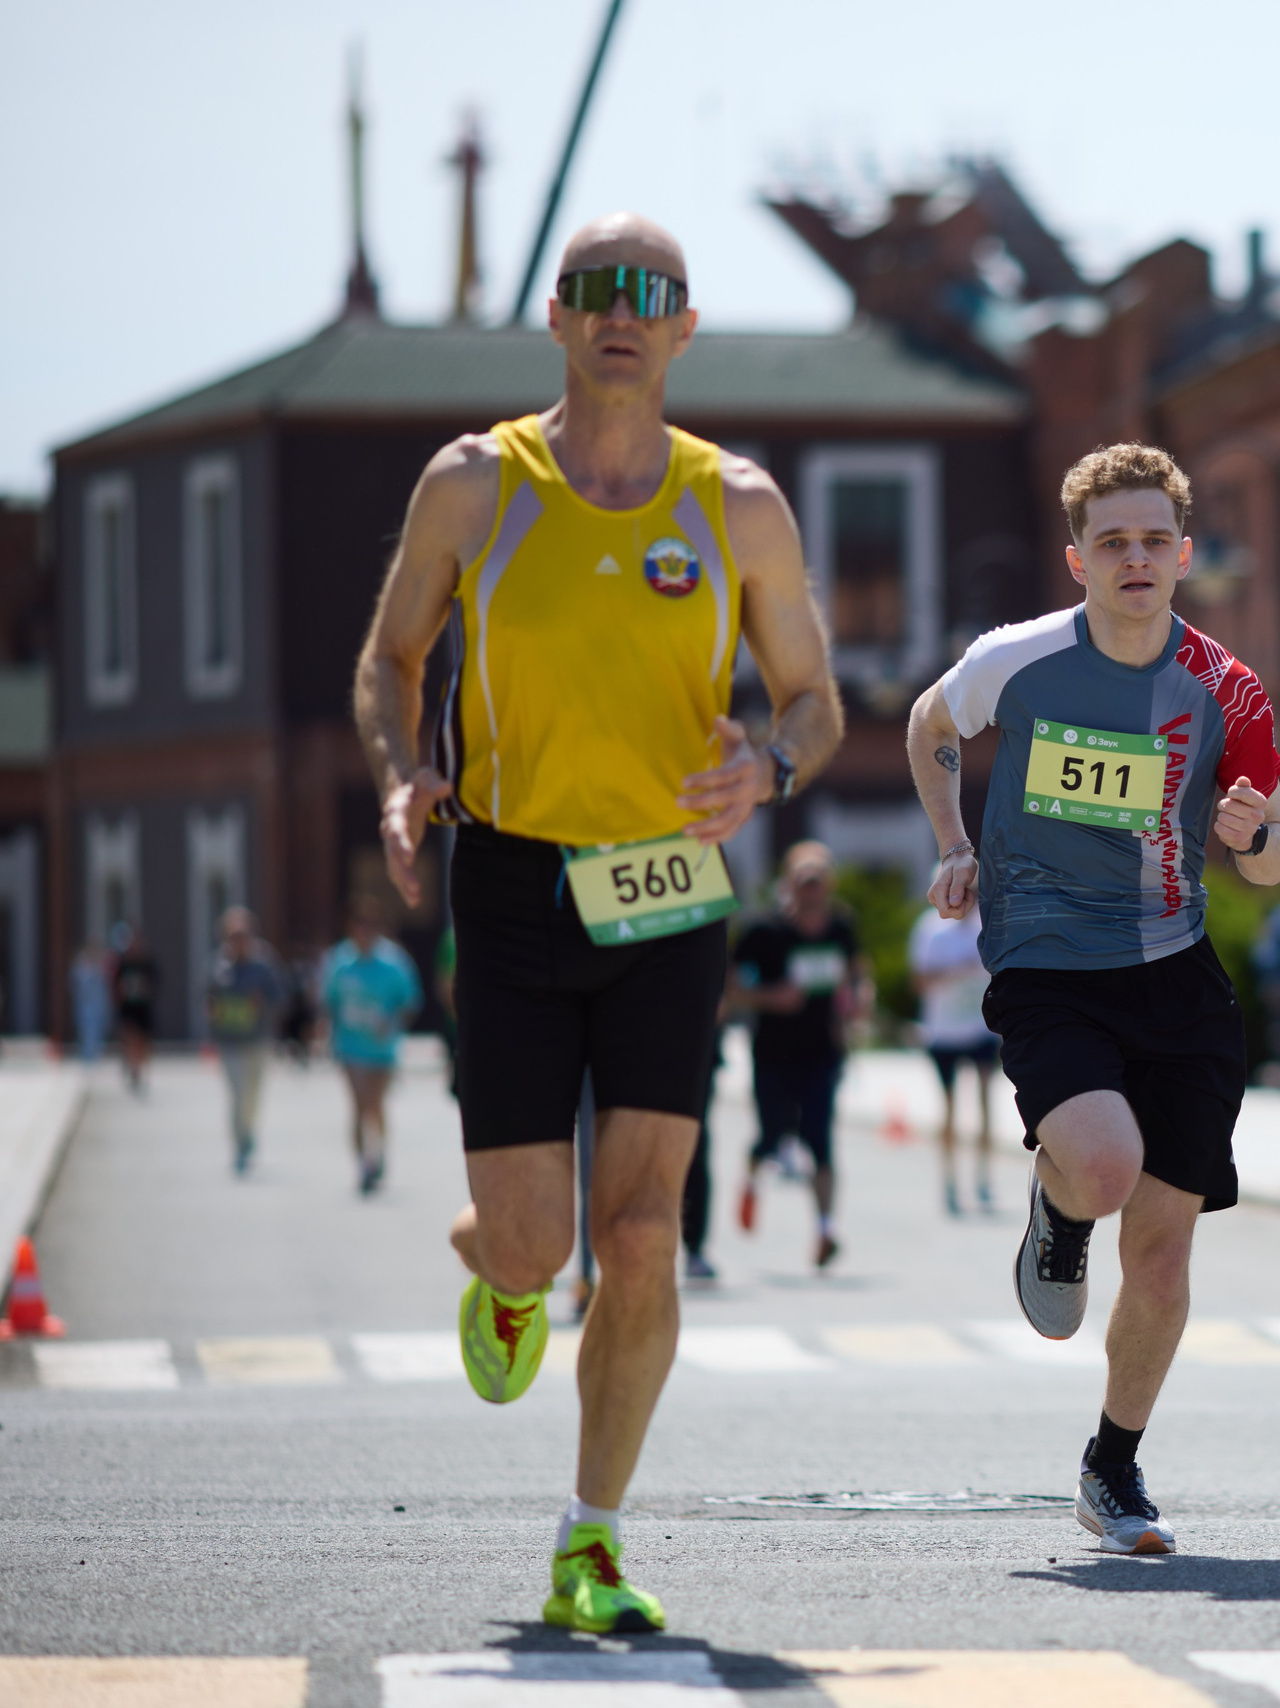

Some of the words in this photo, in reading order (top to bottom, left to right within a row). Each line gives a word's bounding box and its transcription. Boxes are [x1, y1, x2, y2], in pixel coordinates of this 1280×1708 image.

[1097, 738, 1119, 748] Звук
[1060, 756, 1131, 799] 511
[610, 855, 692, 904] 560
